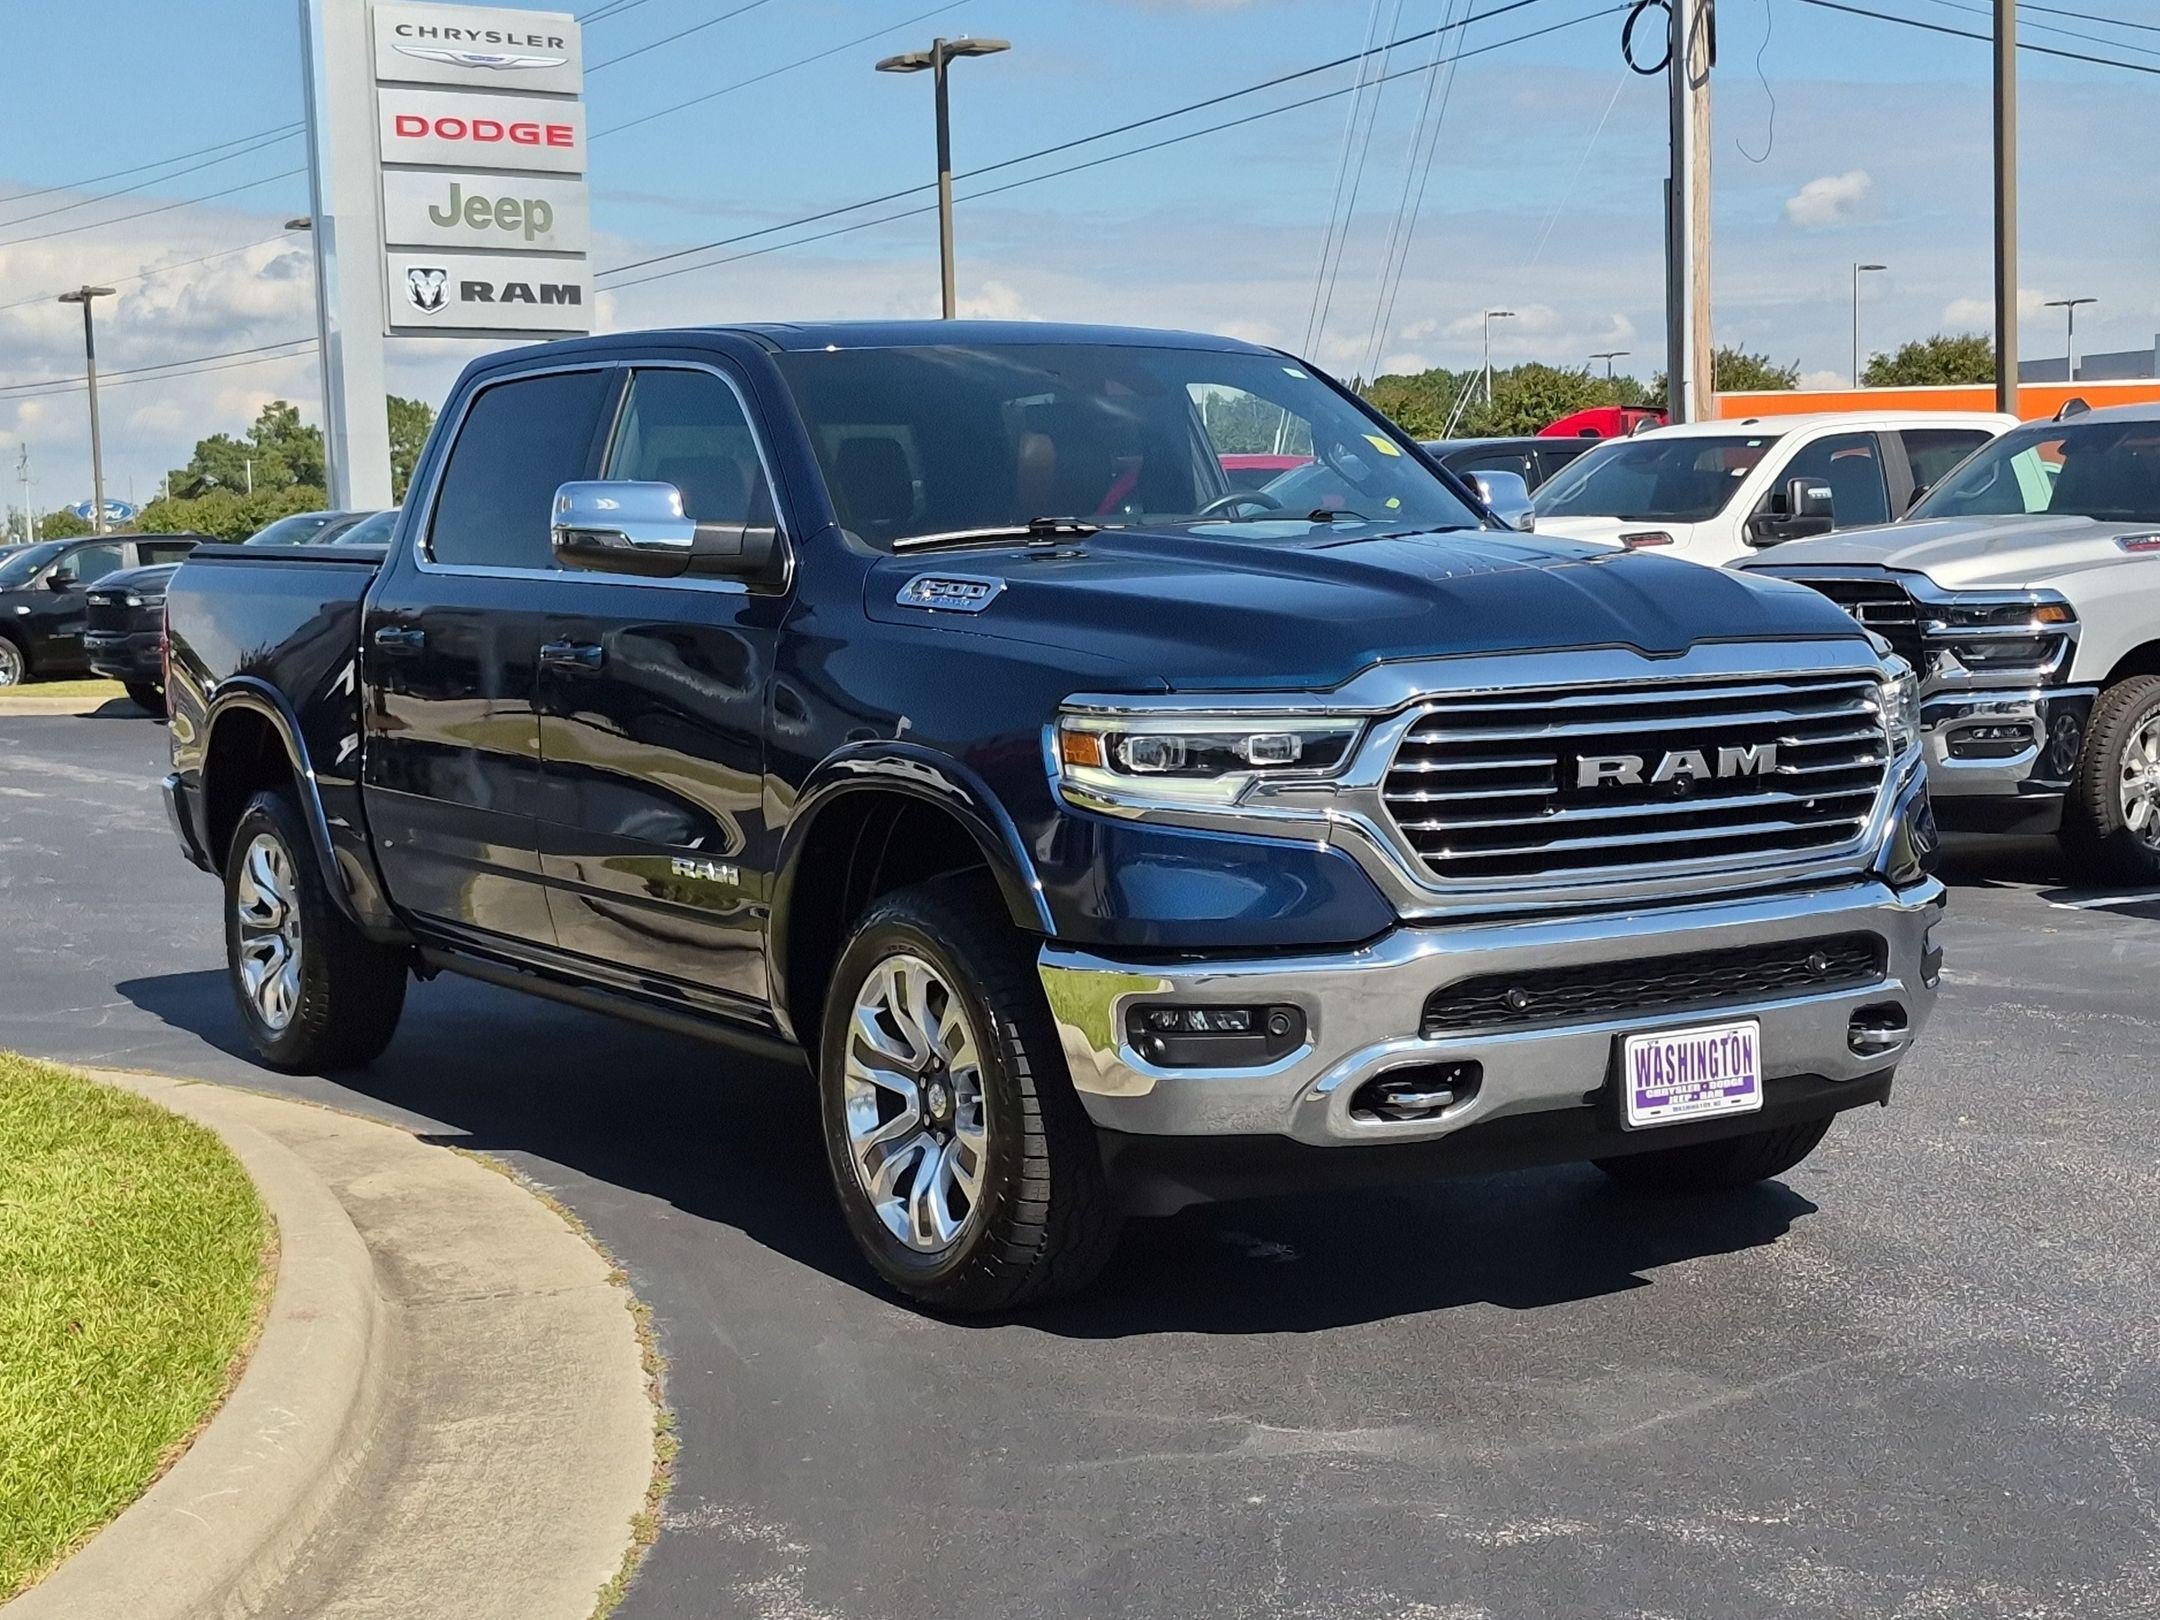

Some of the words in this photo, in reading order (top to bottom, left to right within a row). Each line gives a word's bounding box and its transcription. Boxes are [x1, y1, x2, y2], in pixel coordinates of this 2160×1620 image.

[395, 24, 565, 49] CHRYSLER
[395, 115, 574, 147] DODGE
[428, 182, 554, 241] Jeep
[460, 281, 582, 305] RAM
[1577, 744, 1777, 788] RAM
[671, 856, 739, 886] RAM
[1635, 1035, 1752, 1088] WASHINGTON
